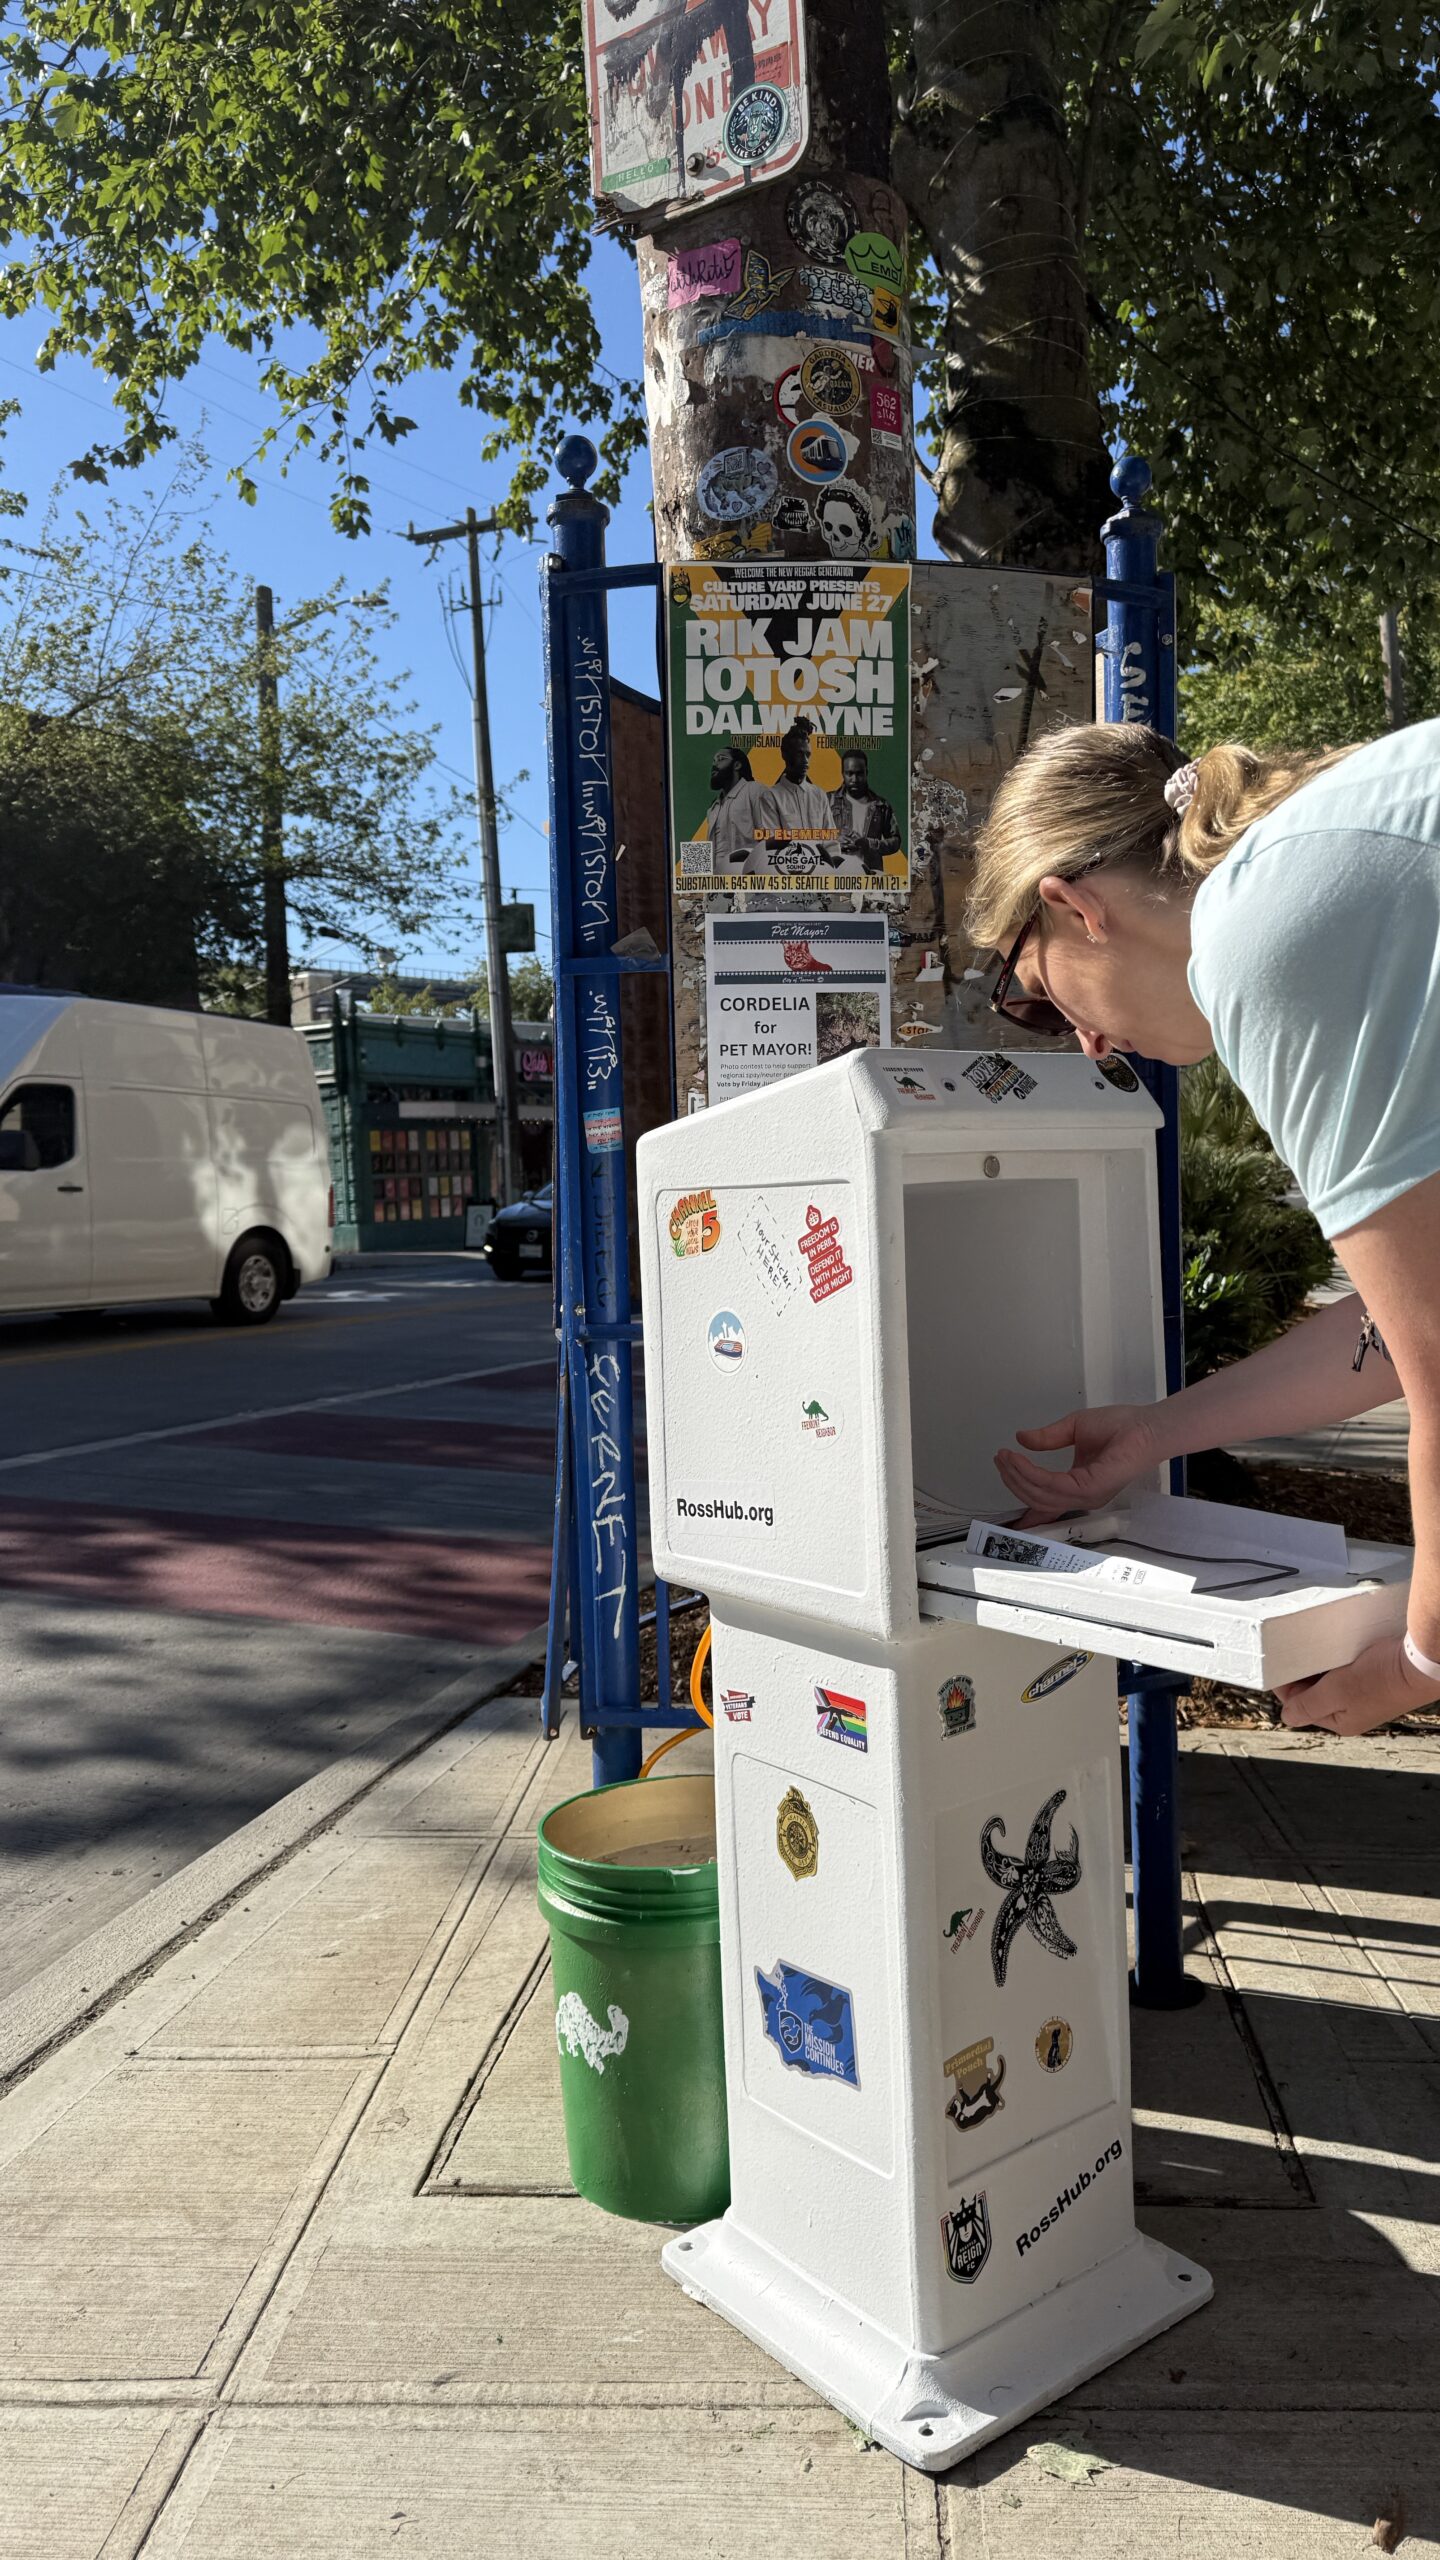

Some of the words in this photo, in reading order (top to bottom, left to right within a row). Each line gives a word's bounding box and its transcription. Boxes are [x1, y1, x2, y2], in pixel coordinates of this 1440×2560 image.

[739, 99, 750, 112] BE
[751, 91, 778, 109] KIND
[733, 143, 750, 159] LIKE
[618, 164, 656, 183] HELLO
[808, 350, 847, 365] GARDENA
[876, 392, 896, 410] 562
[734, 567, 765, 578] WELCOME
[766, 567, 777, 577] THE
[778, 567, 793, 577] NEW
[794, 567, 817, 577] REGGAE
[817, 566, 854, 577] GENERATION
[703, 580, 766, 594] CULTURE
[768, 579, 807, 593] YARD
[810, 580, 881, 593] PRESENTS
[690, 593, 804, 612] SATURDAY
[806, 593, 863, 612] JUNE
[865, 595, 894, 613] 27
[685, 618, 775, 657] RIK
[782, 617, 894, 659] JAM
[685, 657, 895, 704] IOTOSH
[686, 704, 894, 737] DALWAYNE
[732, 736, 752, 748] WITH
[754, 736, 781, 748] ISLAND
[816, 736, 861, 749] FEDERATION
[862, 737, 882, 750] BAND
[754, 829, 772, 841] DJ
[774, 828, 840, 841] ELEMENT
[768, 854, 798, 866] ZIONS
[801, 855, 825, 866] GATE
[675, 877, 729, 892] SUBSTATION:
[731, 877, 748, 890] 645
[750, 877, 765, 890] NW
[768, 877, 780, 890] 45
[781, 877, 794, 890] ST.
[796, 876, 830, 890] SEATTLE
[834, 875, 861, 890] DOORS
[864, 876, 870, 889] 7
[871, 876, 885, 889] PM
[890, 876, 900, 890] 21
[771, 925, 790, 937] Pet
[791, 925, 830, 938] Mayor?
[720, 997, 810, 1011] CORDELIA
[754, 1021, 777, 1034] for
[720, 1044, 748, 1056] PET
[752, 1043, 812, 1056] MAYOR!
[669, 1189, 717, 1241] CHANNEL
[702, 1210, 721, 1253] 5
[800, 1226, 830, 1249] FREEDOM
[829, 1221, 838, 1231] IS
[809, 1249, 817, 1258] IN
[816, 1238, 835, 1254] PERIL
[810, 1255, 835, 1275] DEFEND
[834, 1250, 843, 1261] IT
[811, 1284, 830, 1300] YOUR
[830, 1270, 851, 1291] MIGHT
[813, 1271, 830, 1286] WITH
[830, 1263, 844, 1277] ALL
[676, 1498, 774, 1527] RossHub.org
[732, 1711, 749, 1721] VOTE
[819, 1728, 840, 1741] DEFEND
[841, 1732, 866, 1750] EQUALITY
[966, 1907, 986, 1941] NEIGHBOR
[950, 1924, 969, 1955] FREMONT
[804, 2022, 814, 2035] THE
[804, 2034, 836, 2057] MISSION
[944, 2039, 992, 2073] Primordial
[805, 2047, 845, 2076] CONTINUES
[956, 2057, 984, 2078] Pouch
[1015, 2139, 1123, 2257] RossHub.org
[957, 2243, 983, 2269] REIGN
[967, 2261, 976, 2272] FC
